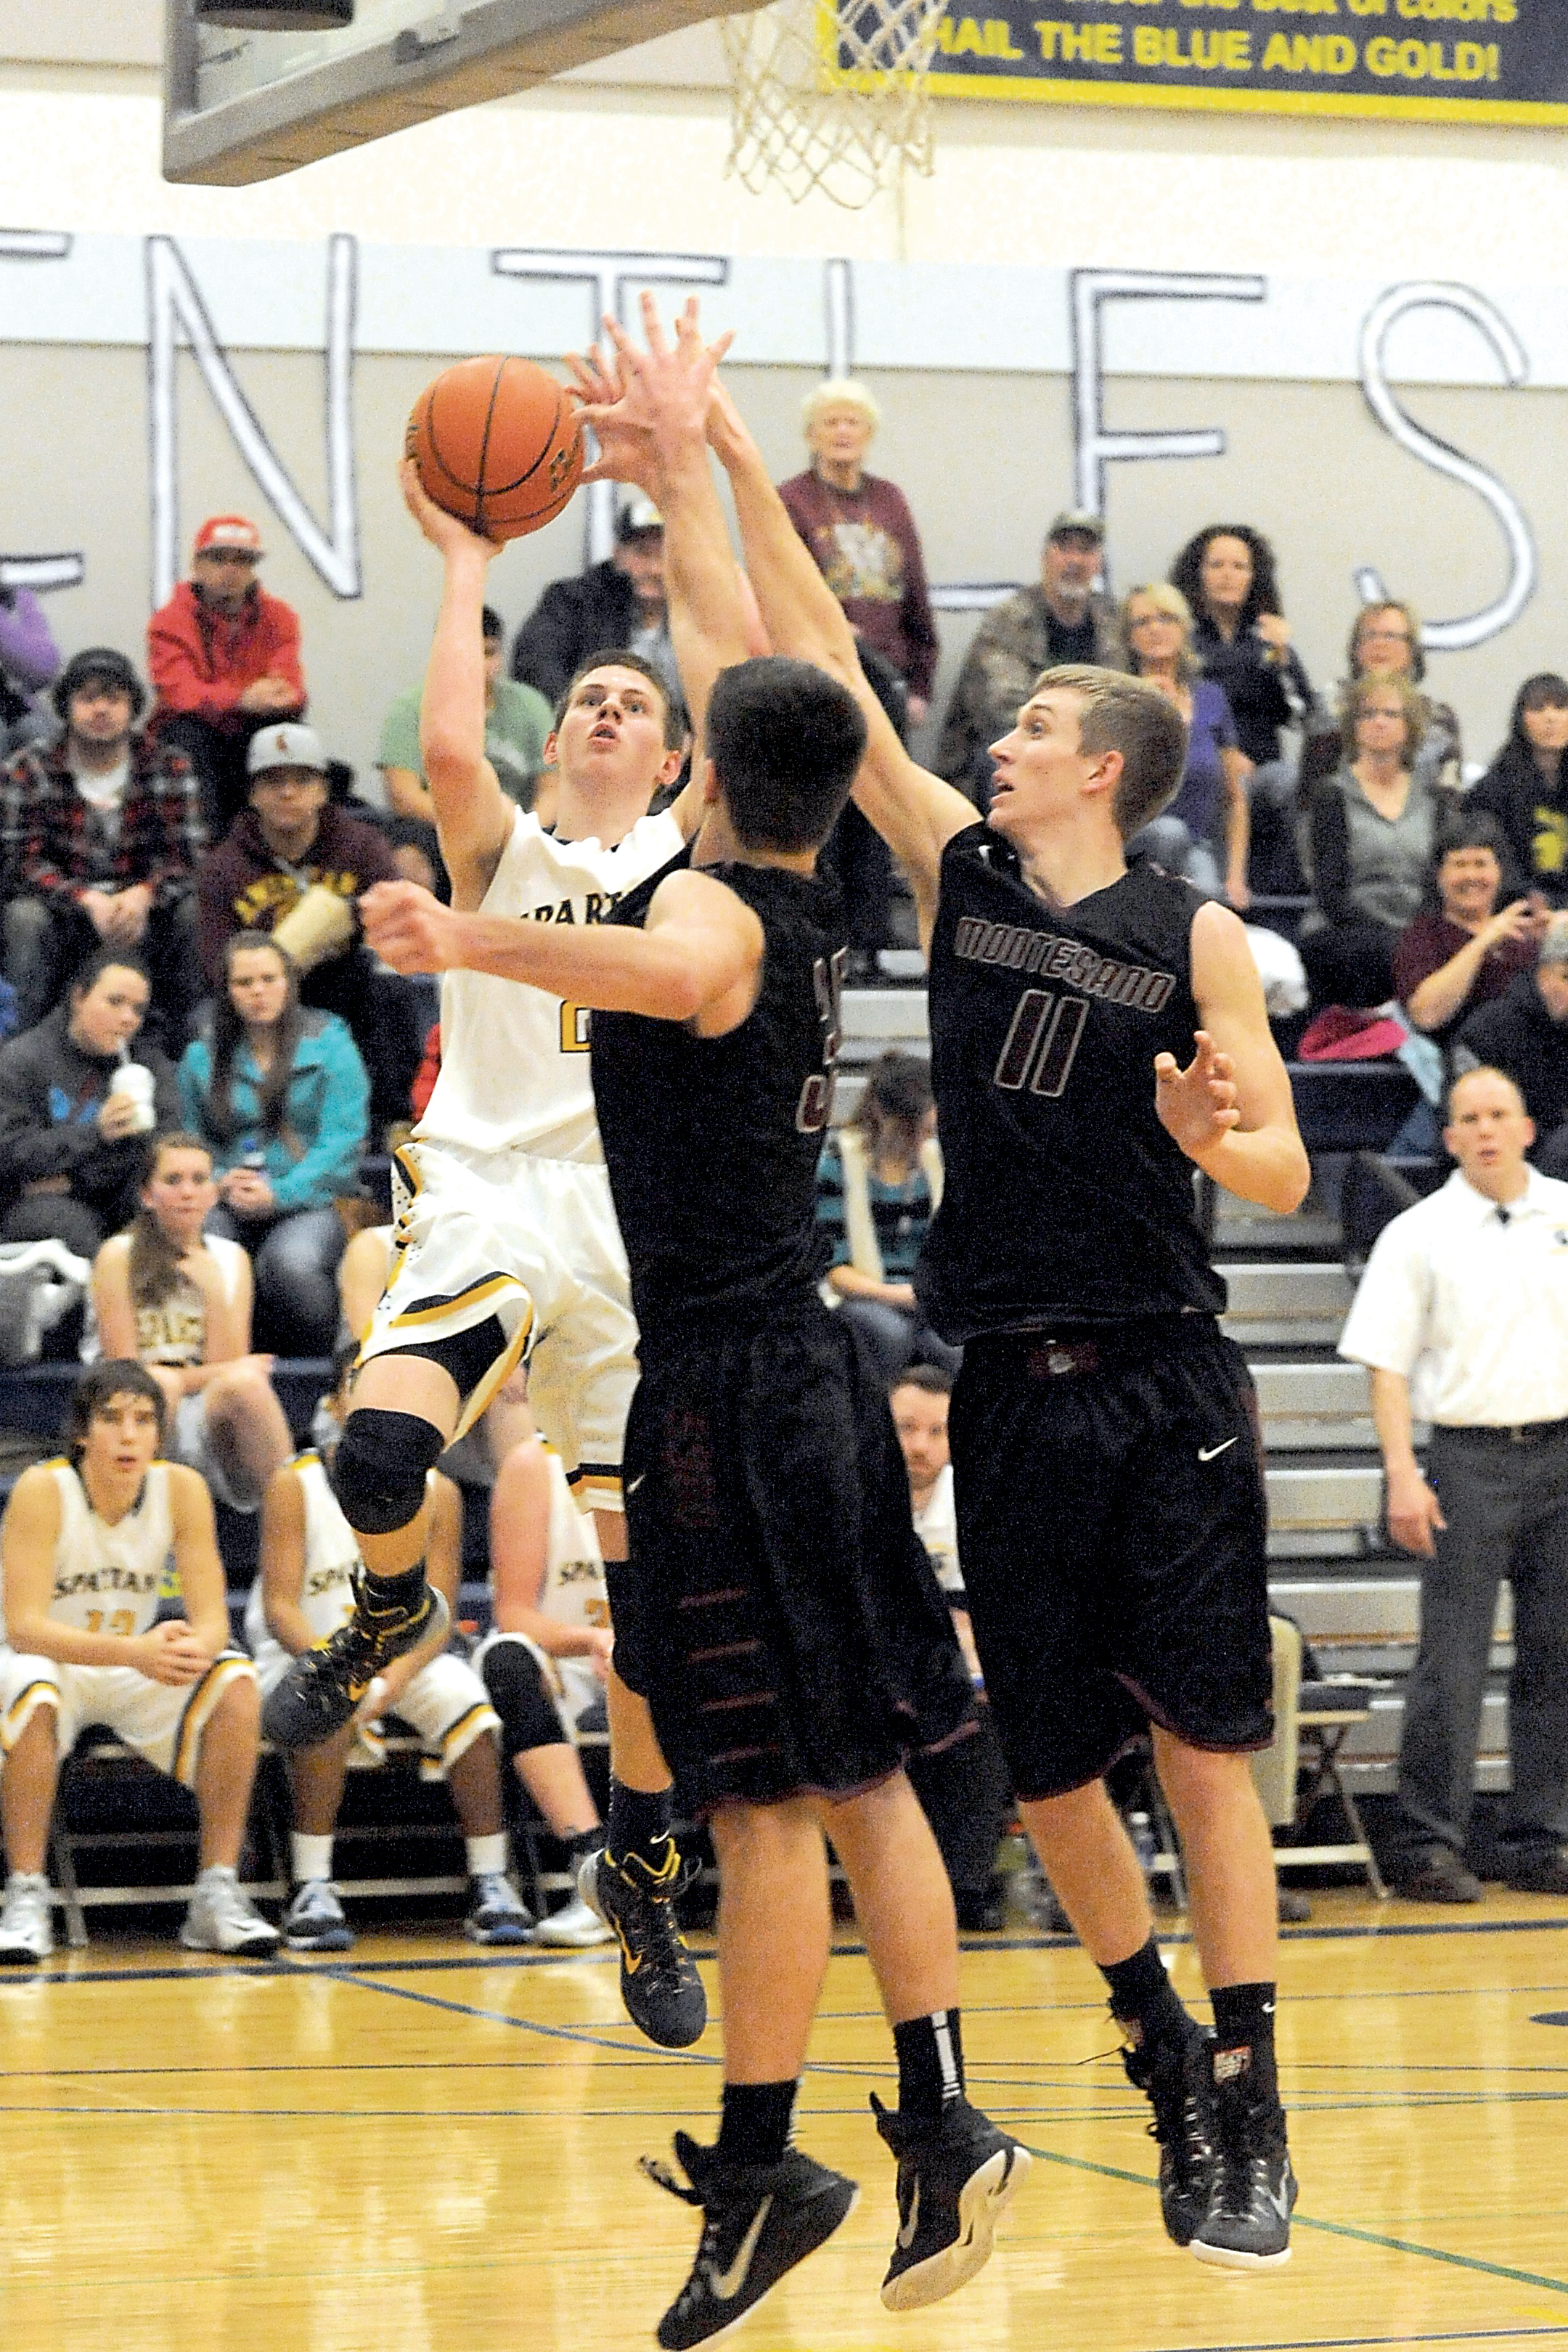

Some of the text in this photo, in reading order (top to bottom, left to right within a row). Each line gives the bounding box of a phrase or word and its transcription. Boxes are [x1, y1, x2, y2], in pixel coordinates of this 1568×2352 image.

[922, 16, 1500, 81] HAIL THE BLUE AND GOLD!
[954, 917, 1177, 1013] MONTESANO
[994, 989, 1088, 1097] 11
